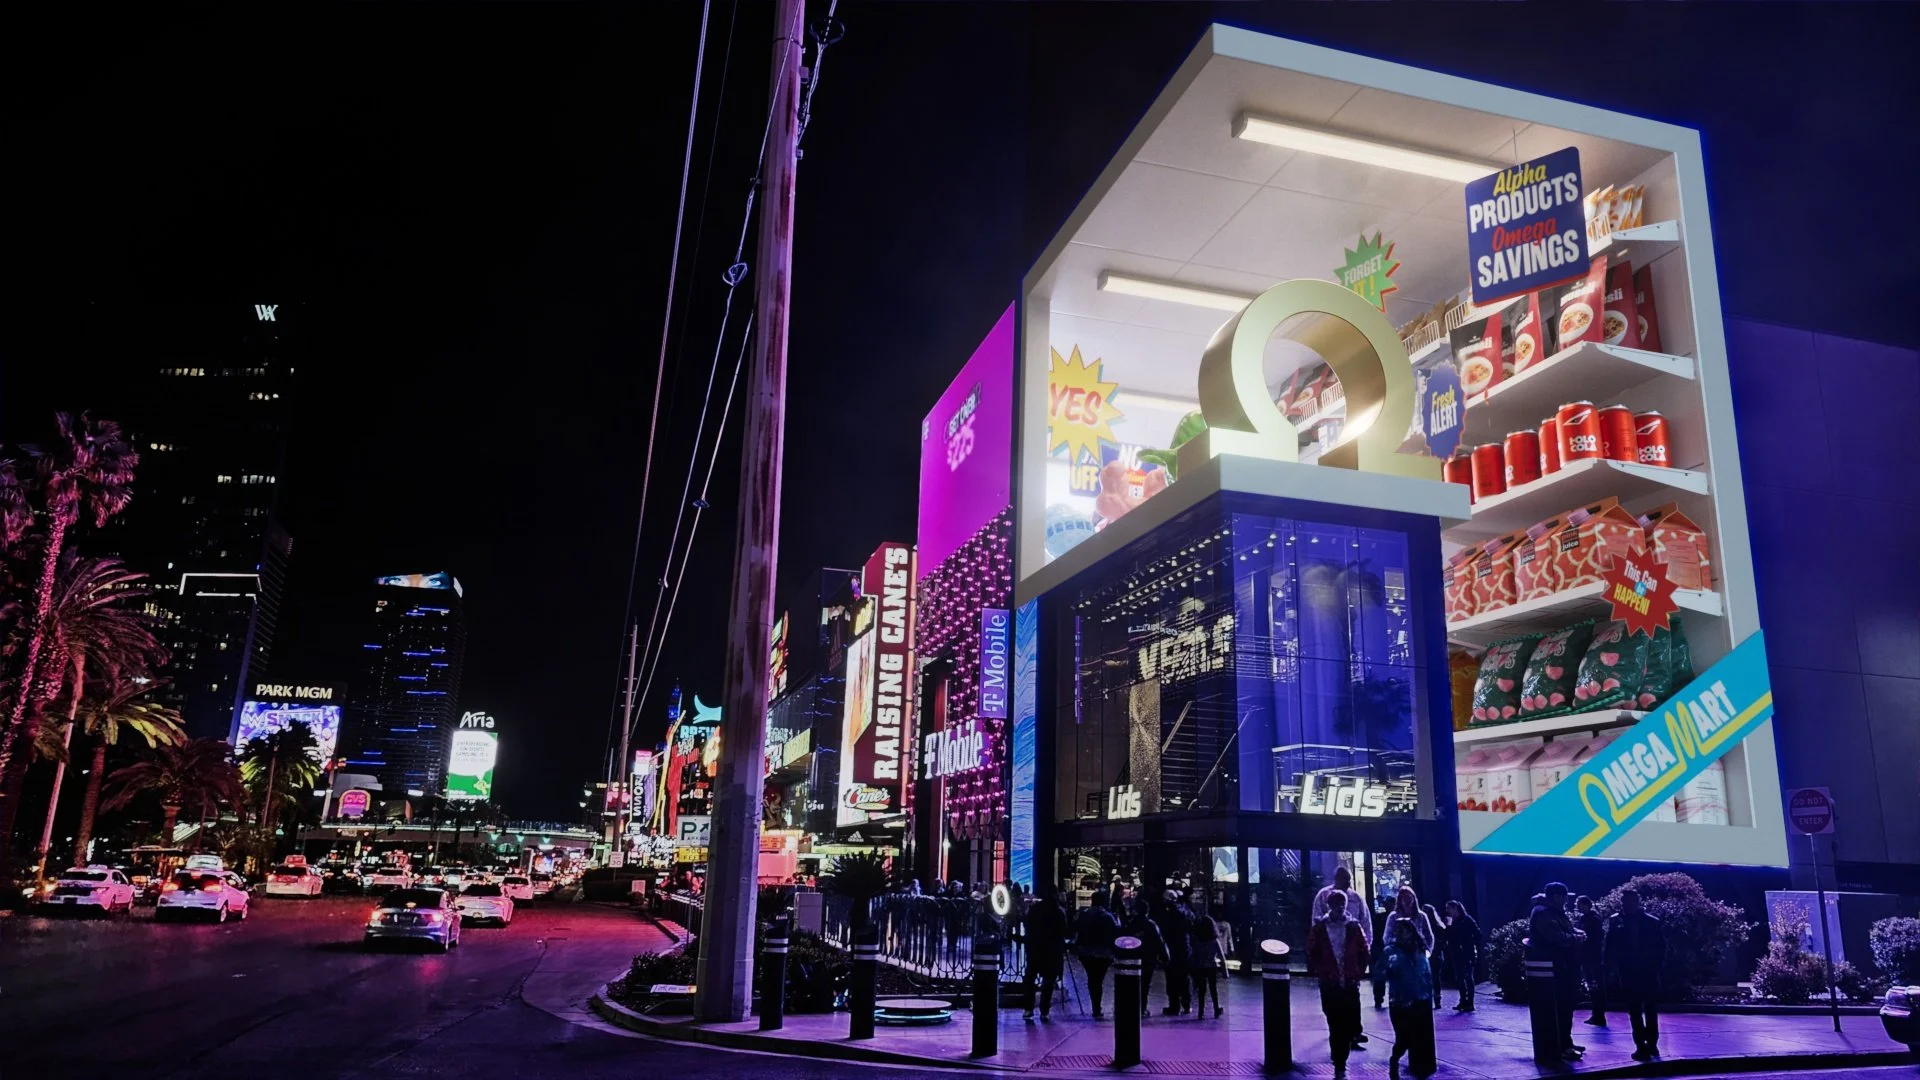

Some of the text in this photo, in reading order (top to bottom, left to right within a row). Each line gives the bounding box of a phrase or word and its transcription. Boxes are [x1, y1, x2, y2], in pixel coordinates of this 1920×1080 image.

[1493, 163, 1546, 197] Alpha
[1469, 172, 1579, 233] PRODUCTS
[1492, 217, 1557, 252] Omega
[1344, 253, 1382, 288] FORGET
[1477, 229, 1580, 288] SAVINGS
[1050, 382, 1102, 426] YES
[1432, 383, 1455, 413] Fresh
[1430, 400, 1458, 437] ALERT
[1570, 442, 1598, 453] COLA
[1639, 452, 1667, 462] COLA
[1562, 540, 1579, 551] juice
[1624, 559, 1658, 593] This Can
[874, 547, 909, 781] RAISING CANE'S
[255, 683, 333, 700] PARK MGM
[459, 711, 495, 729] Aria
[1664, 680, 1737, 760] MART
[344, 793, 366, 804] CVS
[632, 773, 645, 817] ROSS
[846, 787, 891, 808] Cane's
[1108, 784, 1141, 820] Lids
[1300, 774, 1385, 818] Lids
[1793, 796, 1823, 806] DO NOT
[1799, 816, 1824, 826] ENTER
